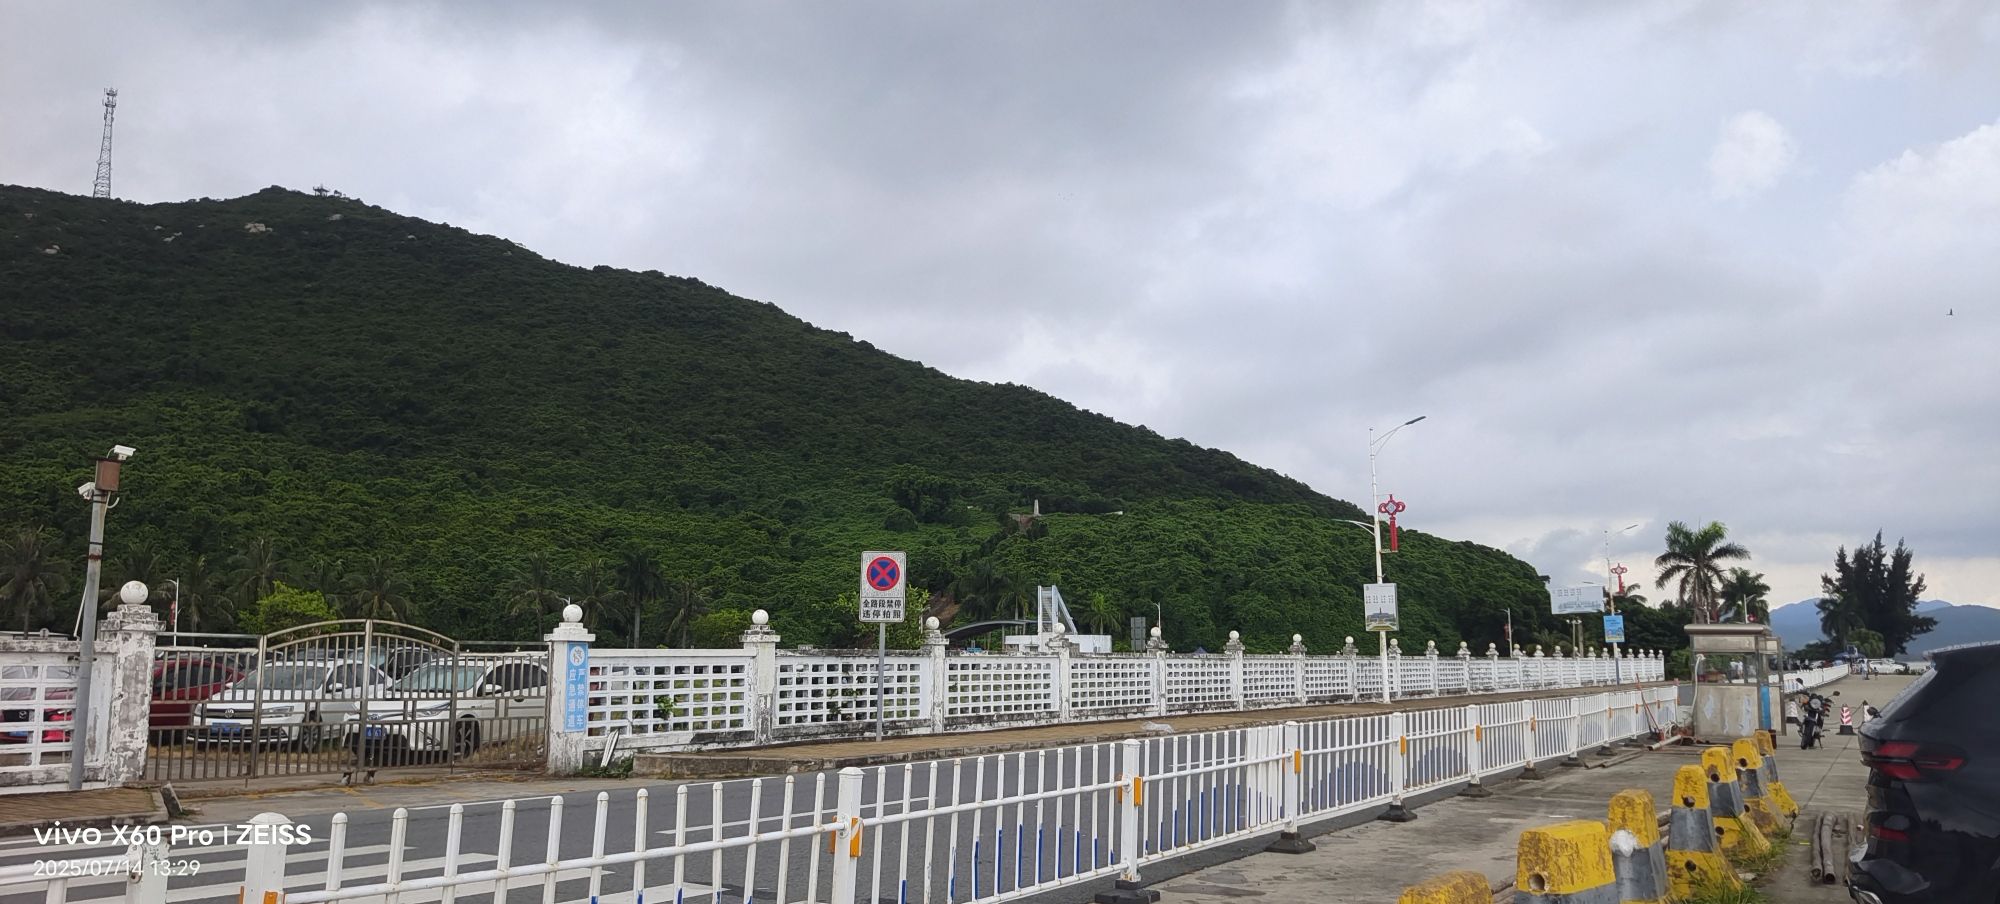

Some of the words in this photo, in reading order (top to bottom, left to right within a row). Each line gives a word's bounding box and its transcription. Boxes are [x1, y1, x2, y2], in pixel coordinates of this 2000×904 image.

[863, 599, 901, 608] 全路段禁停
[567, 668, 577, 727] 应急通道
[576, 668, 586, 727] 严禁停车
